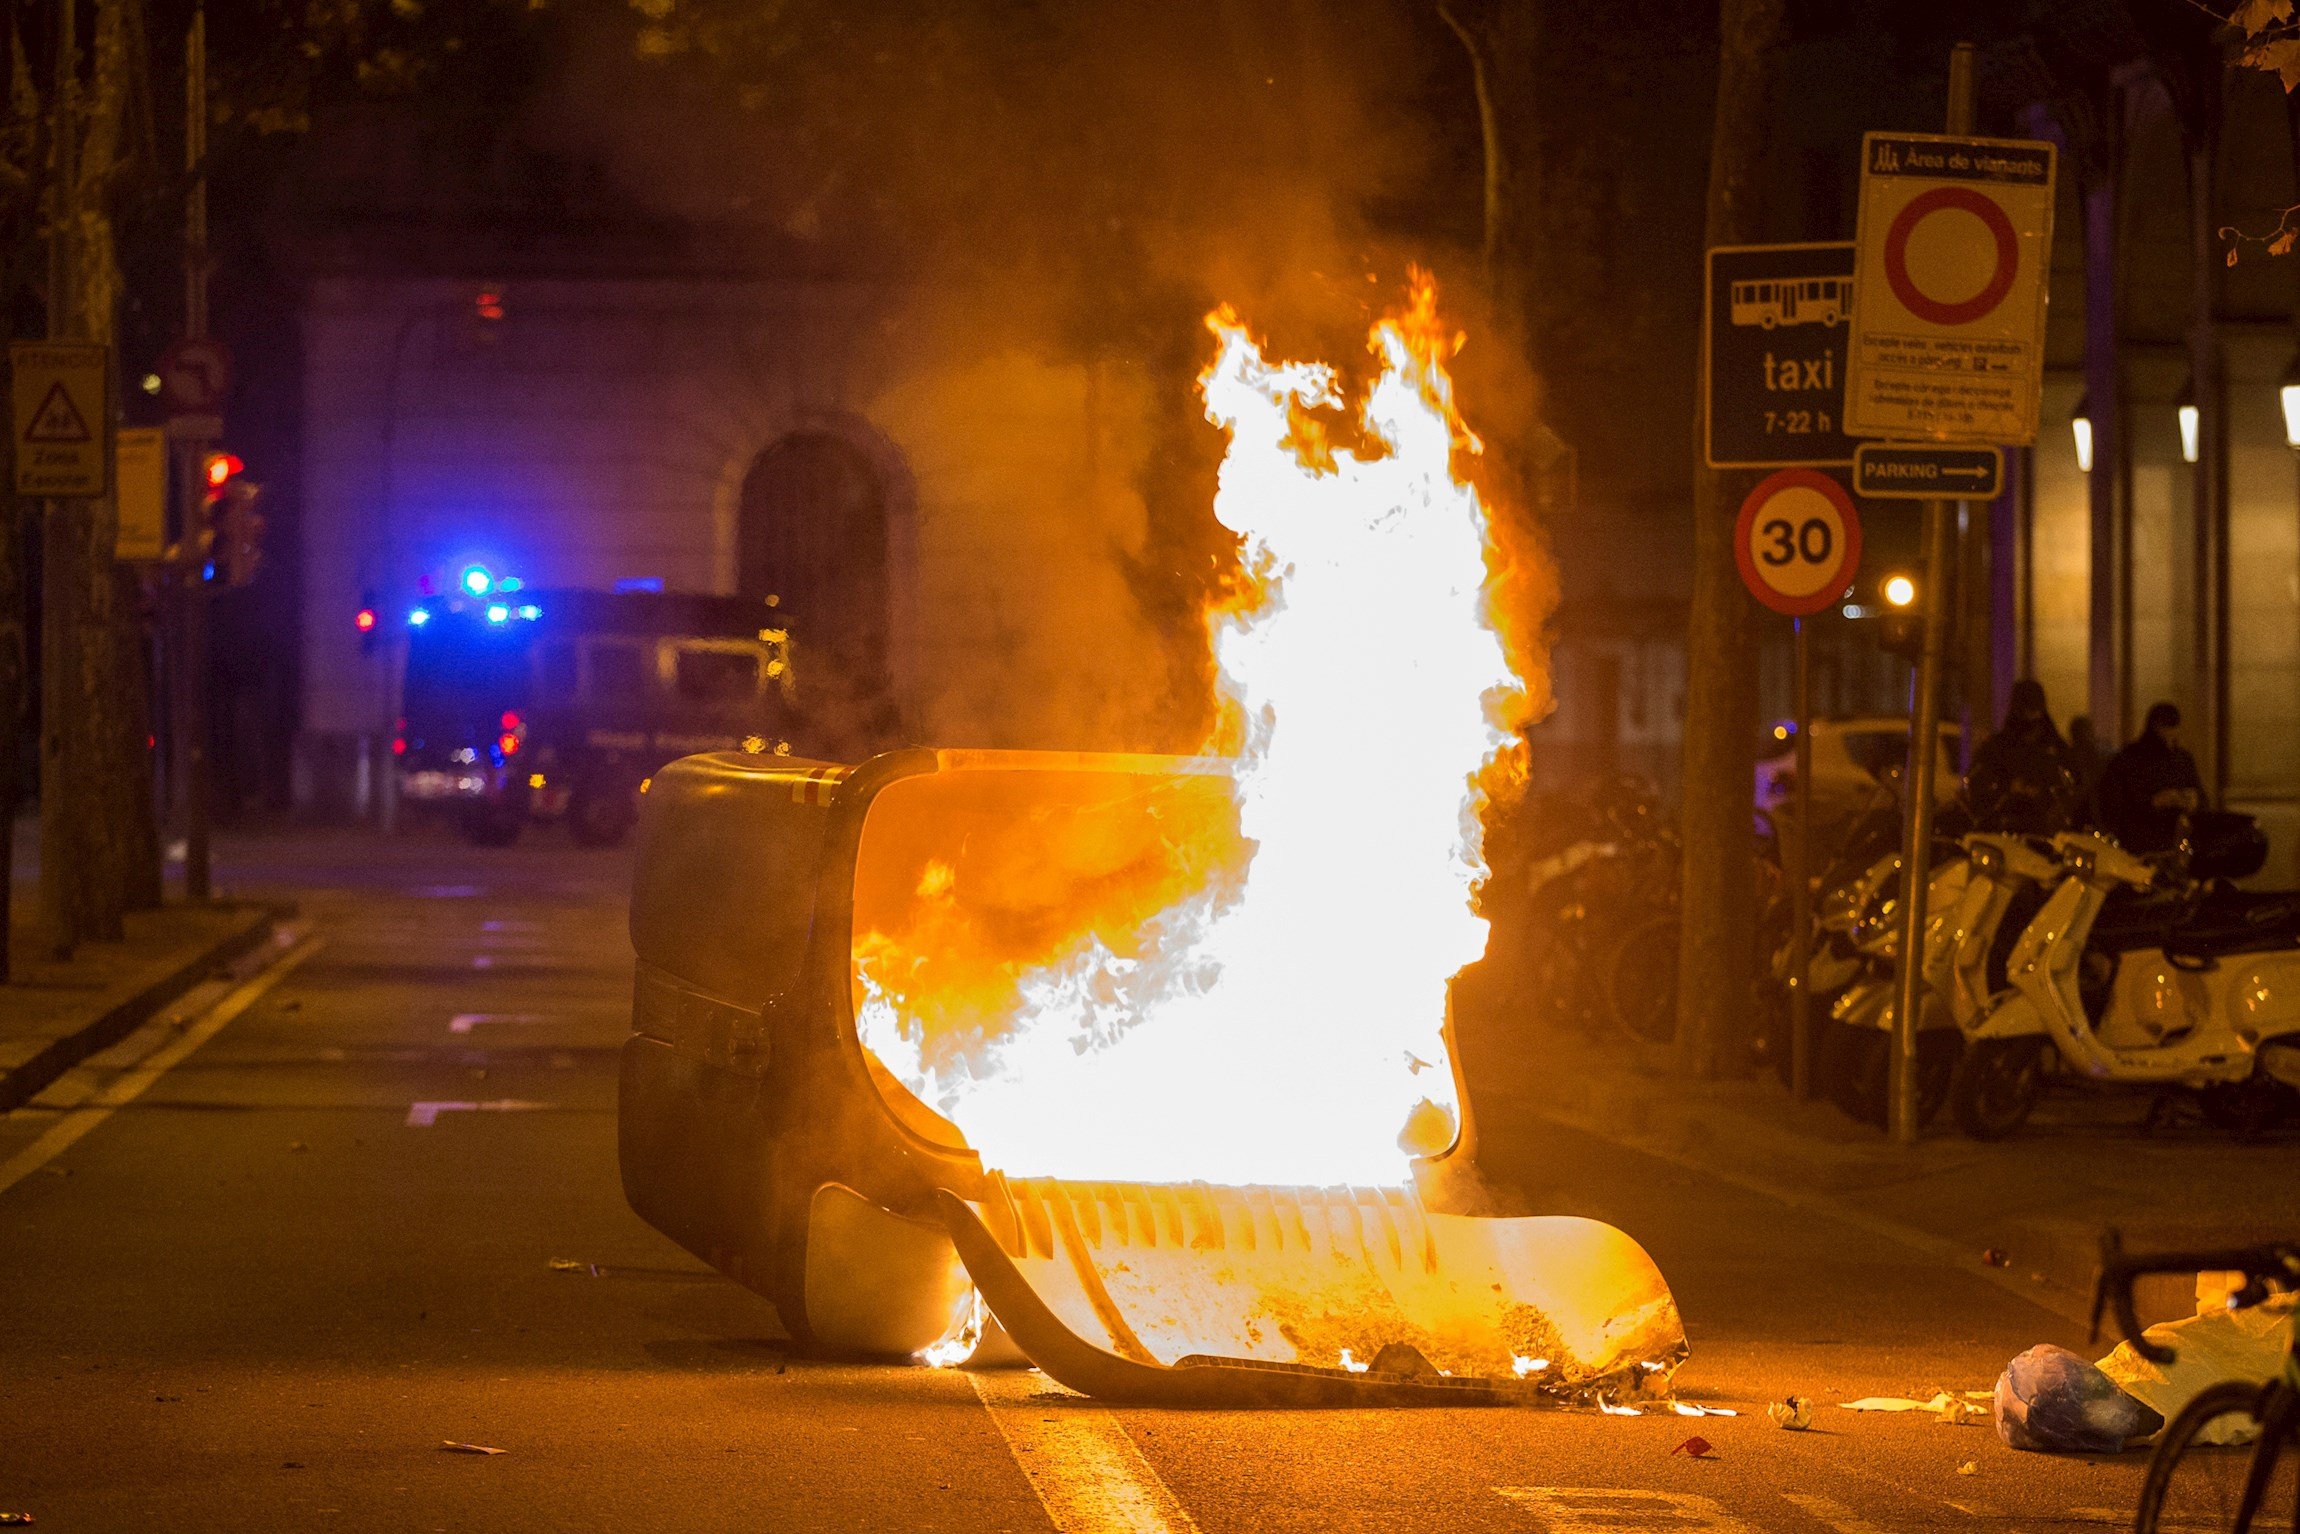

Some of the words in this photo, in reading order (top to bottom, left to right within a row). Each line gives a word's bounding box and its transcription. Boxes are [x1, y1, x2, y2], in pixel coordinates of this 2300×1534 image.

[1905, 146, 1944, 168] Àrea
[1948, 153, 1969, 170] de
[1763, 347, 1833, 391] taxi
[1764, 411, 1811, 433] 7-22
[1818, 411, 1831, 432] h
[1865, 463, 1937, 478] PARKING
[1762, 518, 1832, 566] 30
